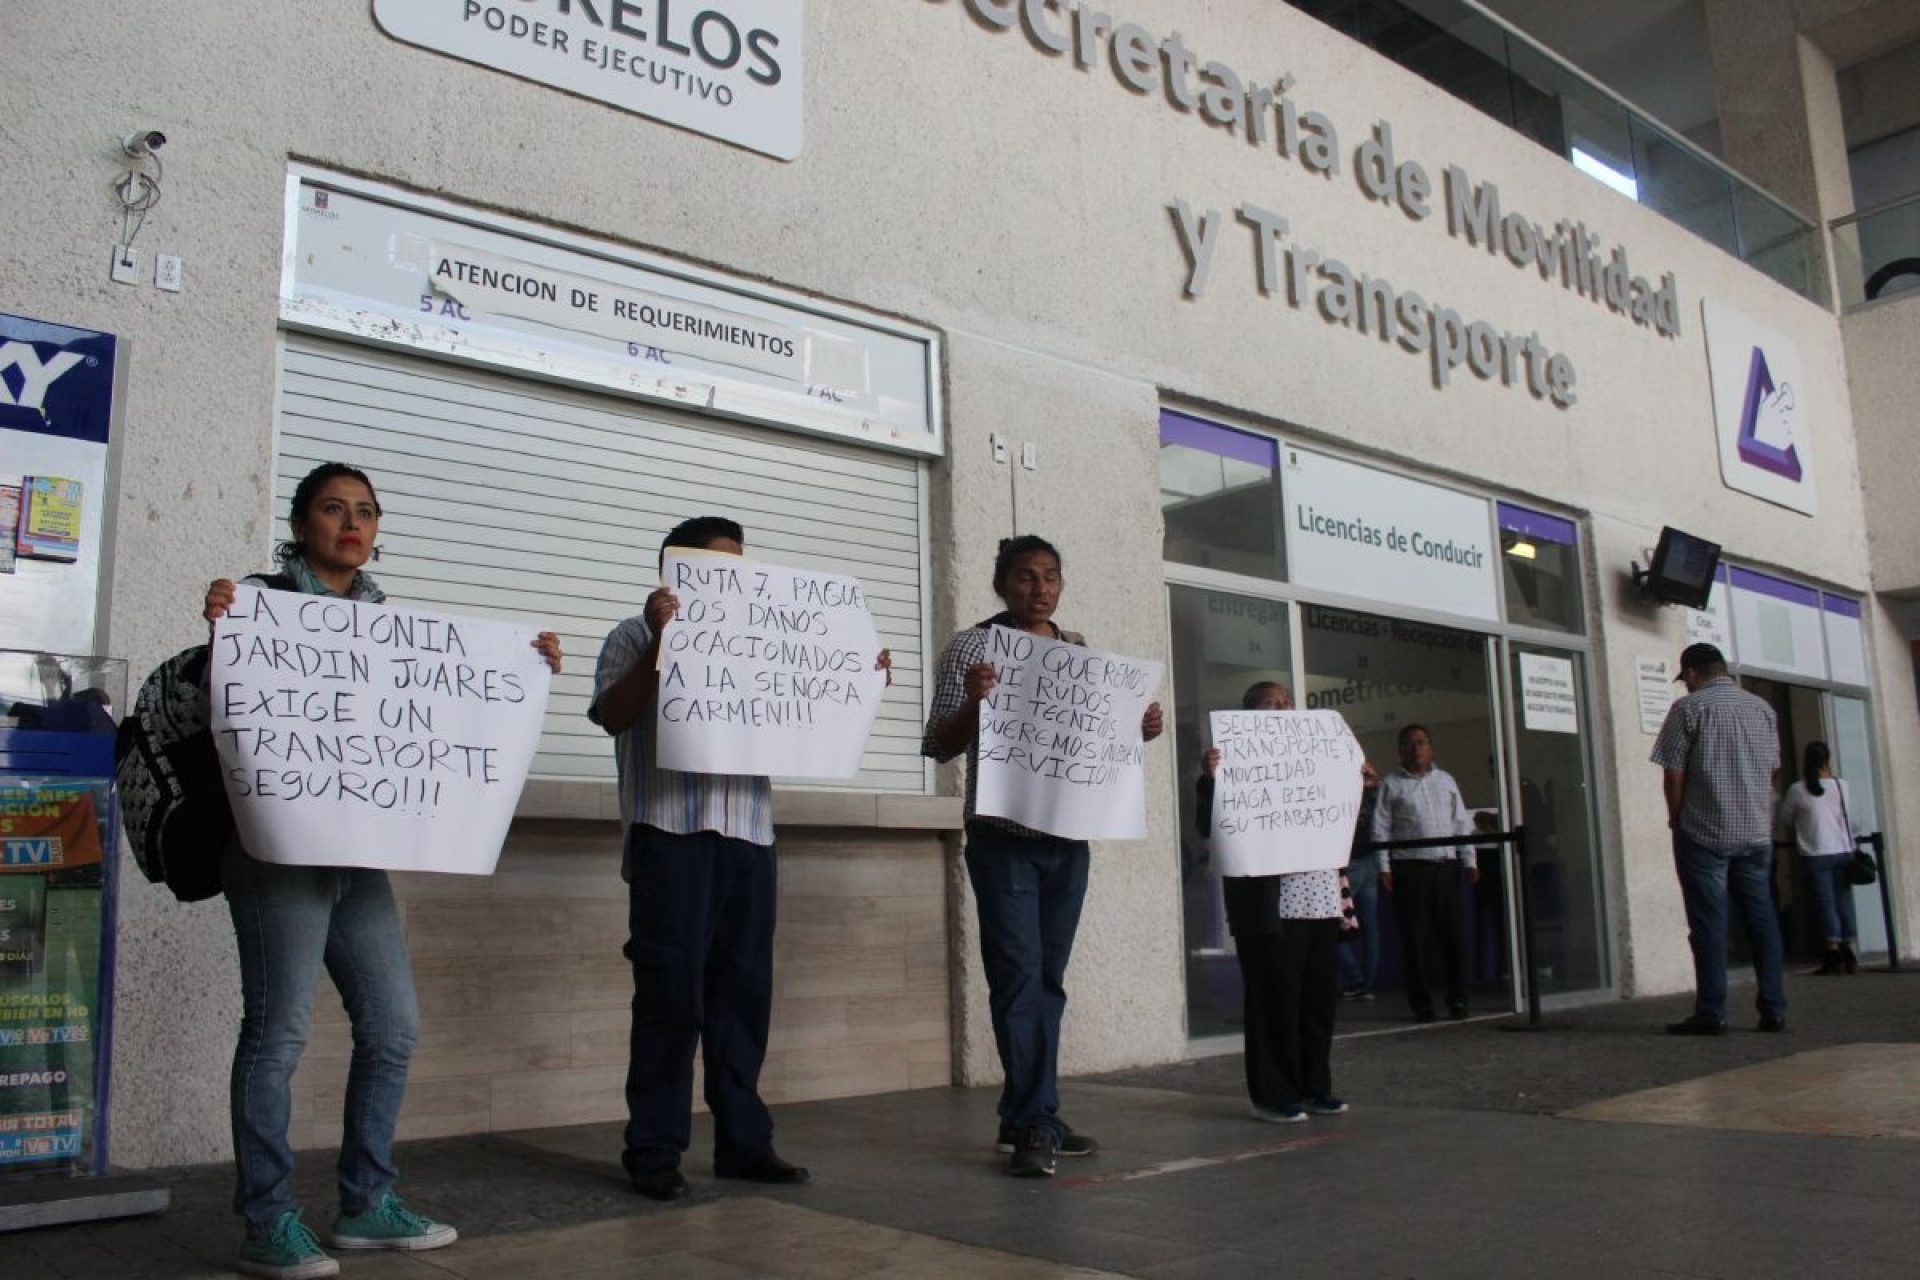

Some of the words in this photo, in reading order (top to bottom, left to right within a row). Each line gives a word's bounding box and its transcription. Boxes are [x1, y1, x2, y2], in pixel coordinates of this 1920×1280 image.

[463, 0, 568, 53] PODER
[583, 38, 733, 106] EJECUTIVO
[557, 0, 782, 85] ELOS
[920, 0, 1340, 176] cretaría
[1354, 119, 1431, 222] de
[1446, 164, 1682, 339] Movilidad
[420, 295, 433, 313] 5
[436, 258, 556, 301] ATENCION
[571, 289, 598, 312] DE
[614, 298, 795, 358] REQUERIMIENTOS
[1168, 198, 1220, 299] y
[1236, 202, 1577, 407] Transporte
[628, 342, 639, 357] 6
[1298, 504, 1381, 548] Licencias
[1386, 524, 1408, 553] de
[1412, 533, 1483, 569] Conducir
[676, 562, 742, 595] RUTA
[226, 590, 280, 627] LA
[299, 601, 466, 657] COLONIA
[674, 599, 726, 623] LOS
[749, 603, 828, 636] DAÑOS
[1307, 607, 1379, 637] Licencias
[222, 633, 370, 683] JARDIN
[391, 658, 526, 703] JUARES
[669, 630, 862, 674] OCACIONADOS
[994, 628, 1034, 661] NO
[1042, 646, 1150, 698] QUEREMOS
[665, 661, 685, 688] A
[706, 665, 735, 693] LA
[755, 671, 862, 705] SEÑORA
[1036, 675, 1112, 716] RUDOS
[1306, 675, 1425, 708] ométricos
[224, 682, 356, 722] EXIGE
[379, 699, 433, 733] UN
[1218, 714, 1326, 737] SECRETARIA
[221, 728, 500, 784] TRANSPORTE
[1218, 736, 1340, 760] TRANSPORTE
[1223, 758, 1316, 785] MOVILIDAD
[1223, 787, 1272, 811] HAGA
[1282, 785, 1326, 804] BIEN
[1219, 818, 1248, 835] SU
[0, 1070, 67, 1087] REPAGO
